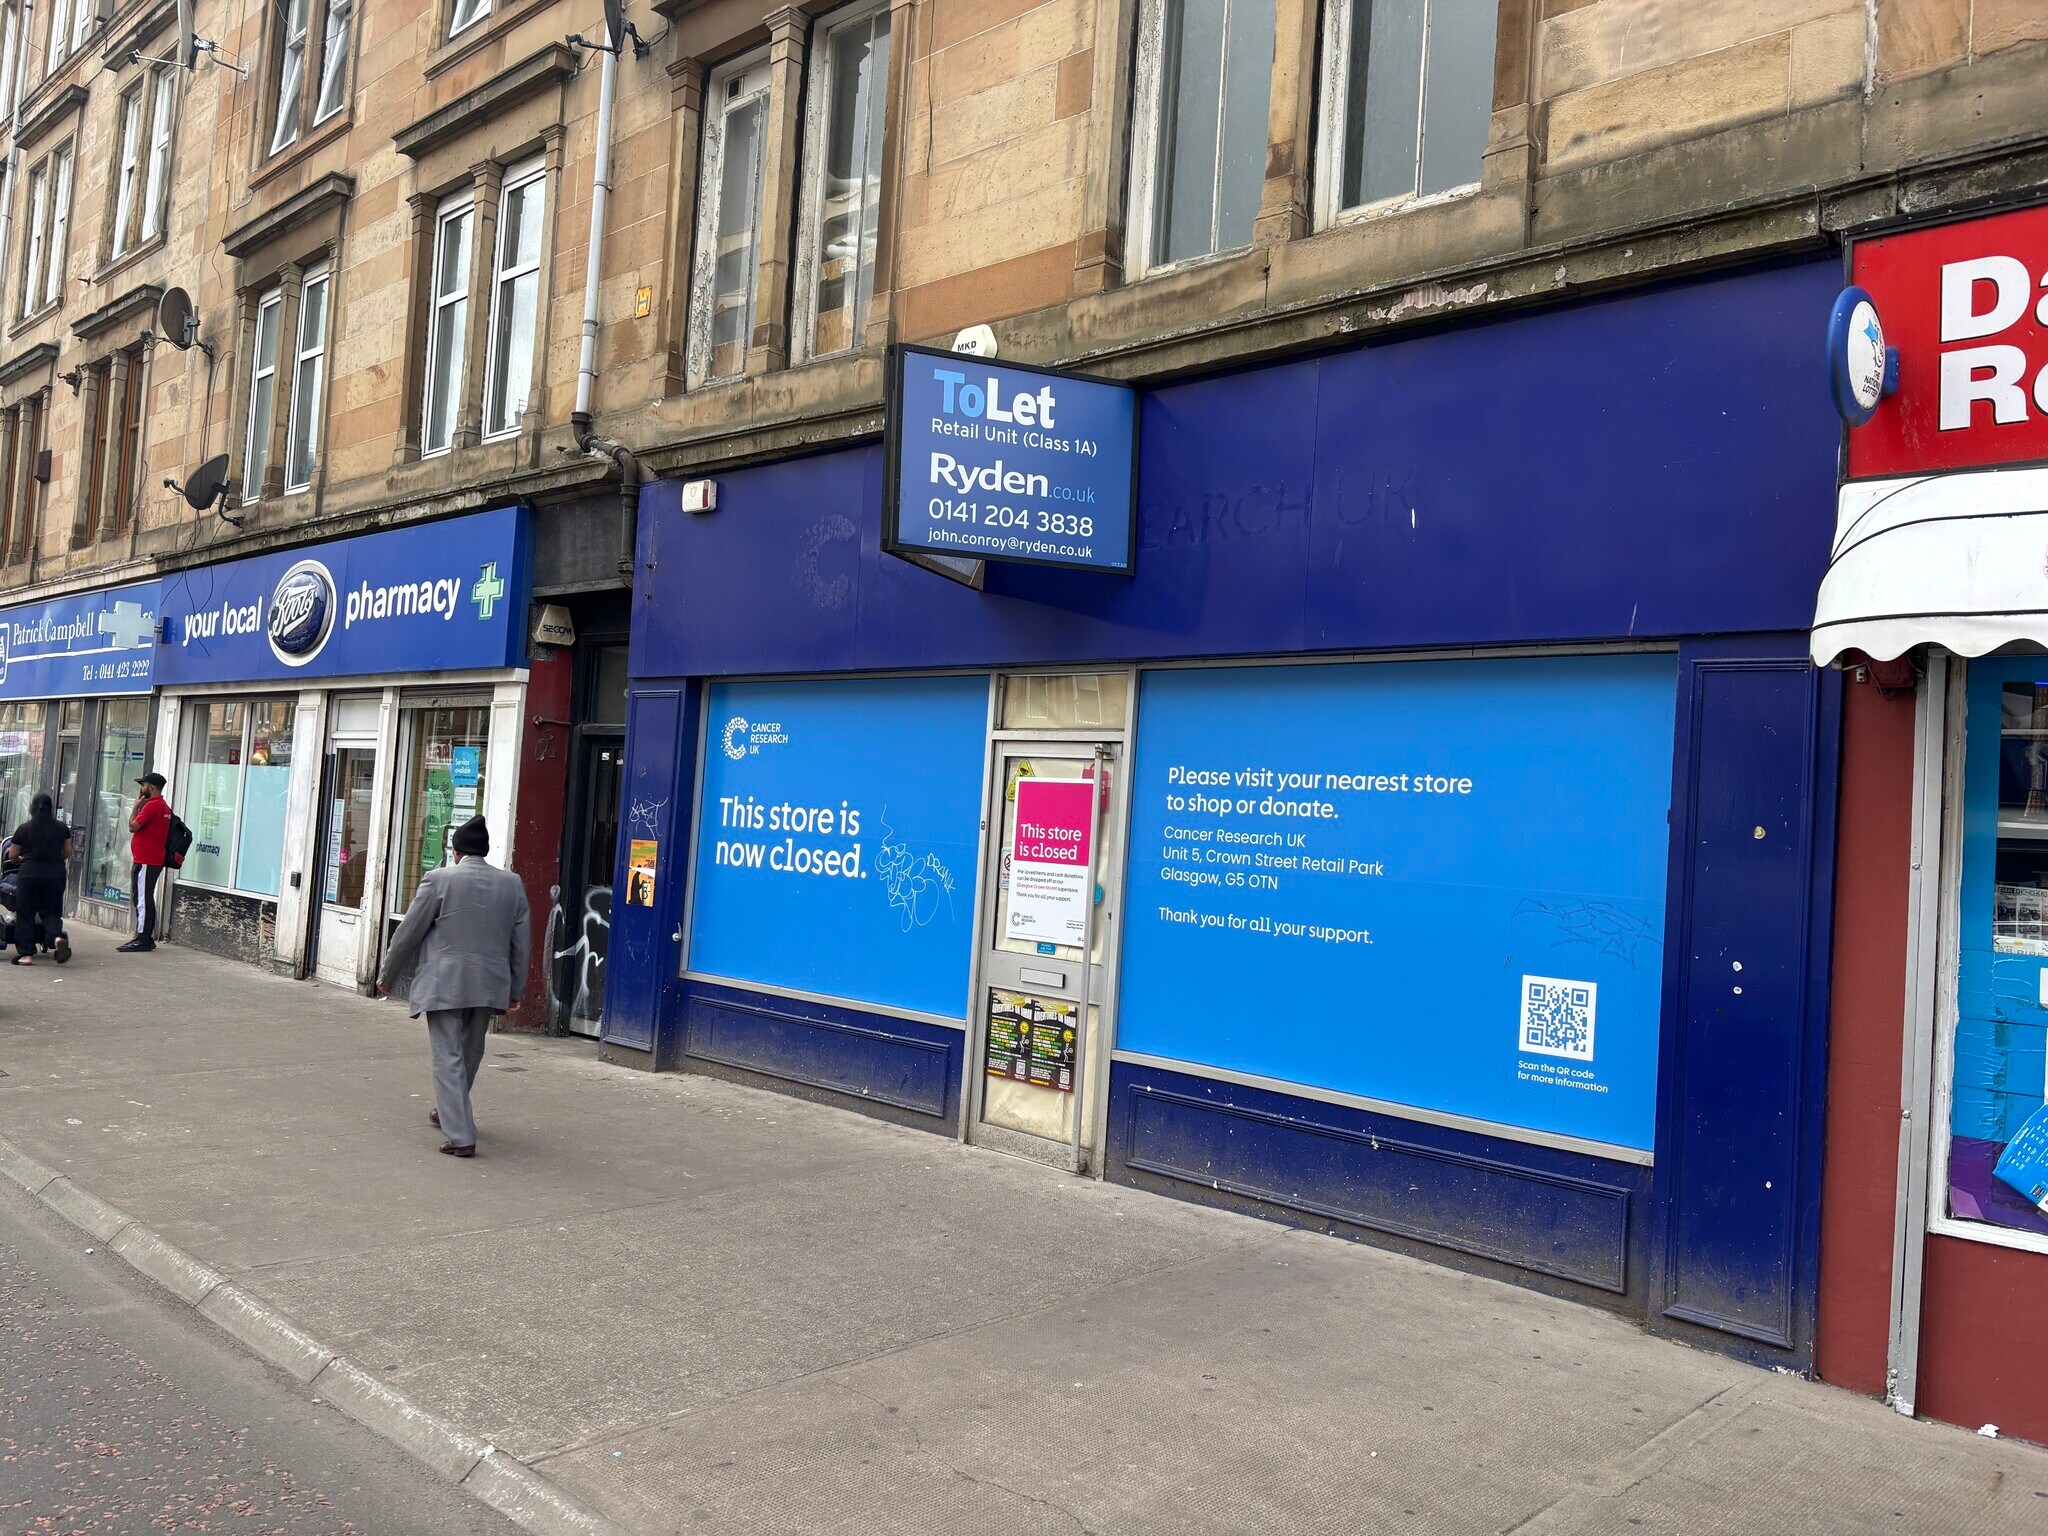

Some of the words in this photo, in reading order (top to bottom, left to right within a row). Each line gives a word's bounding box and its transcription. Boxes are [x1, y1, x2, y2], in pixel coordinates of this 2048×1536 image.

[1940, 256, 2048, 344] D
[958, 340, 977, 352] MKD
[1938, 345, 2048, 432] R
[932, 418, 978, 439] Retail
[985, 425, 1018, 444] Unit
[1024, 431, 1069, 452] (Class
[1074, 439, 1097, 458] 1A)
[928, 498, 976, 524] 0141
[984, 505, 1029, 530] 204
[1036, 511, 1093, 537] 3838
[928, 527, 1092, 558] john.conroy@ryden.co.uk
[182, 610, 220, 646] your
[222, 596, 262, 636] local
[268, 582, 318, 638] Boots
[345, 577, 460, 630] pharmacy
[12, 620, 44, 646] Patrick
[44, 611, 94, 650] Campbell
[543, 624, 572, 635] SECOM
[82, 665, 92, 680] Tel
[100, 663, 114, 679] 0141
[116, 662, 129, 678] 423
[132, 660, 150, 677] 2222
[752, 722, 780, 732] CANCER
[750, 734, 788, 744] RESEARCH
[750, 745, 760, 754] UK
[1168, 766, 1230, 786] Please
[1234, 768, 1272, 787] visit
[1277, 774, 1322, 792] your
[1326, 773, 1408, 792] nearest
[1413, 775, 1472, 794] store
[720, 796, 764, 829] This
[769, 802, 834, 834] store
[840, 800, 860, 836] is
[1166, 794, 1184, 811] to
[1188, 794, 1232, 816] shop
[1236, 800, 1256, 814] or
[1259, 797, 1338, 818] donate.
[1020, 824, 1046, 838] This
[1048, 826, 1082, 841] store
[1164, 826, 1213, 842] Cancer
[1216, 828, 1282, 846] Research
[1287, 833, 1306, 848] UK
[196, 843, 220, 857] pharmacy
[716, 840, 766, 868] now
[770, 838, 866, 878] closed.
[1019, 841, 1029, 856] is
[1032, 843, 1078, 860] closed
[1163, 846, 1188, 861] Unit
[1192, 848, 1202, 864] 5,
[1206, 849, 1251, 866] Crown
[1254, 853, 1298, 869] Street
[1302, 856, 1344, 873] Retail
[1349, 860, 1384, 876] Park
[1160, 868, 1222, 886] Glasgow,
[1225, 872, 1244, 886] G5
[1158, 907, 1198, 924] Thank
[1200, 914, 1224, 928] you
[1228, 914, 1247, 929] for
[1249, 916, 1270, 932] all
[1274, 922, 1306, 936] your
[1308, 926, 1373, 944] support.
[1518, 1060, 1539, 1070] Scan
[1541, 1063, 1555, 1074] the
[1556, 1066, 1570, 1076] QR
[1571, 1068, 1594, 1079] code
[1518, 1071, 1530, 1080] for
[1531, 1074, 1554, 1084] more
[1555, 1077, 1608, 1093] information
